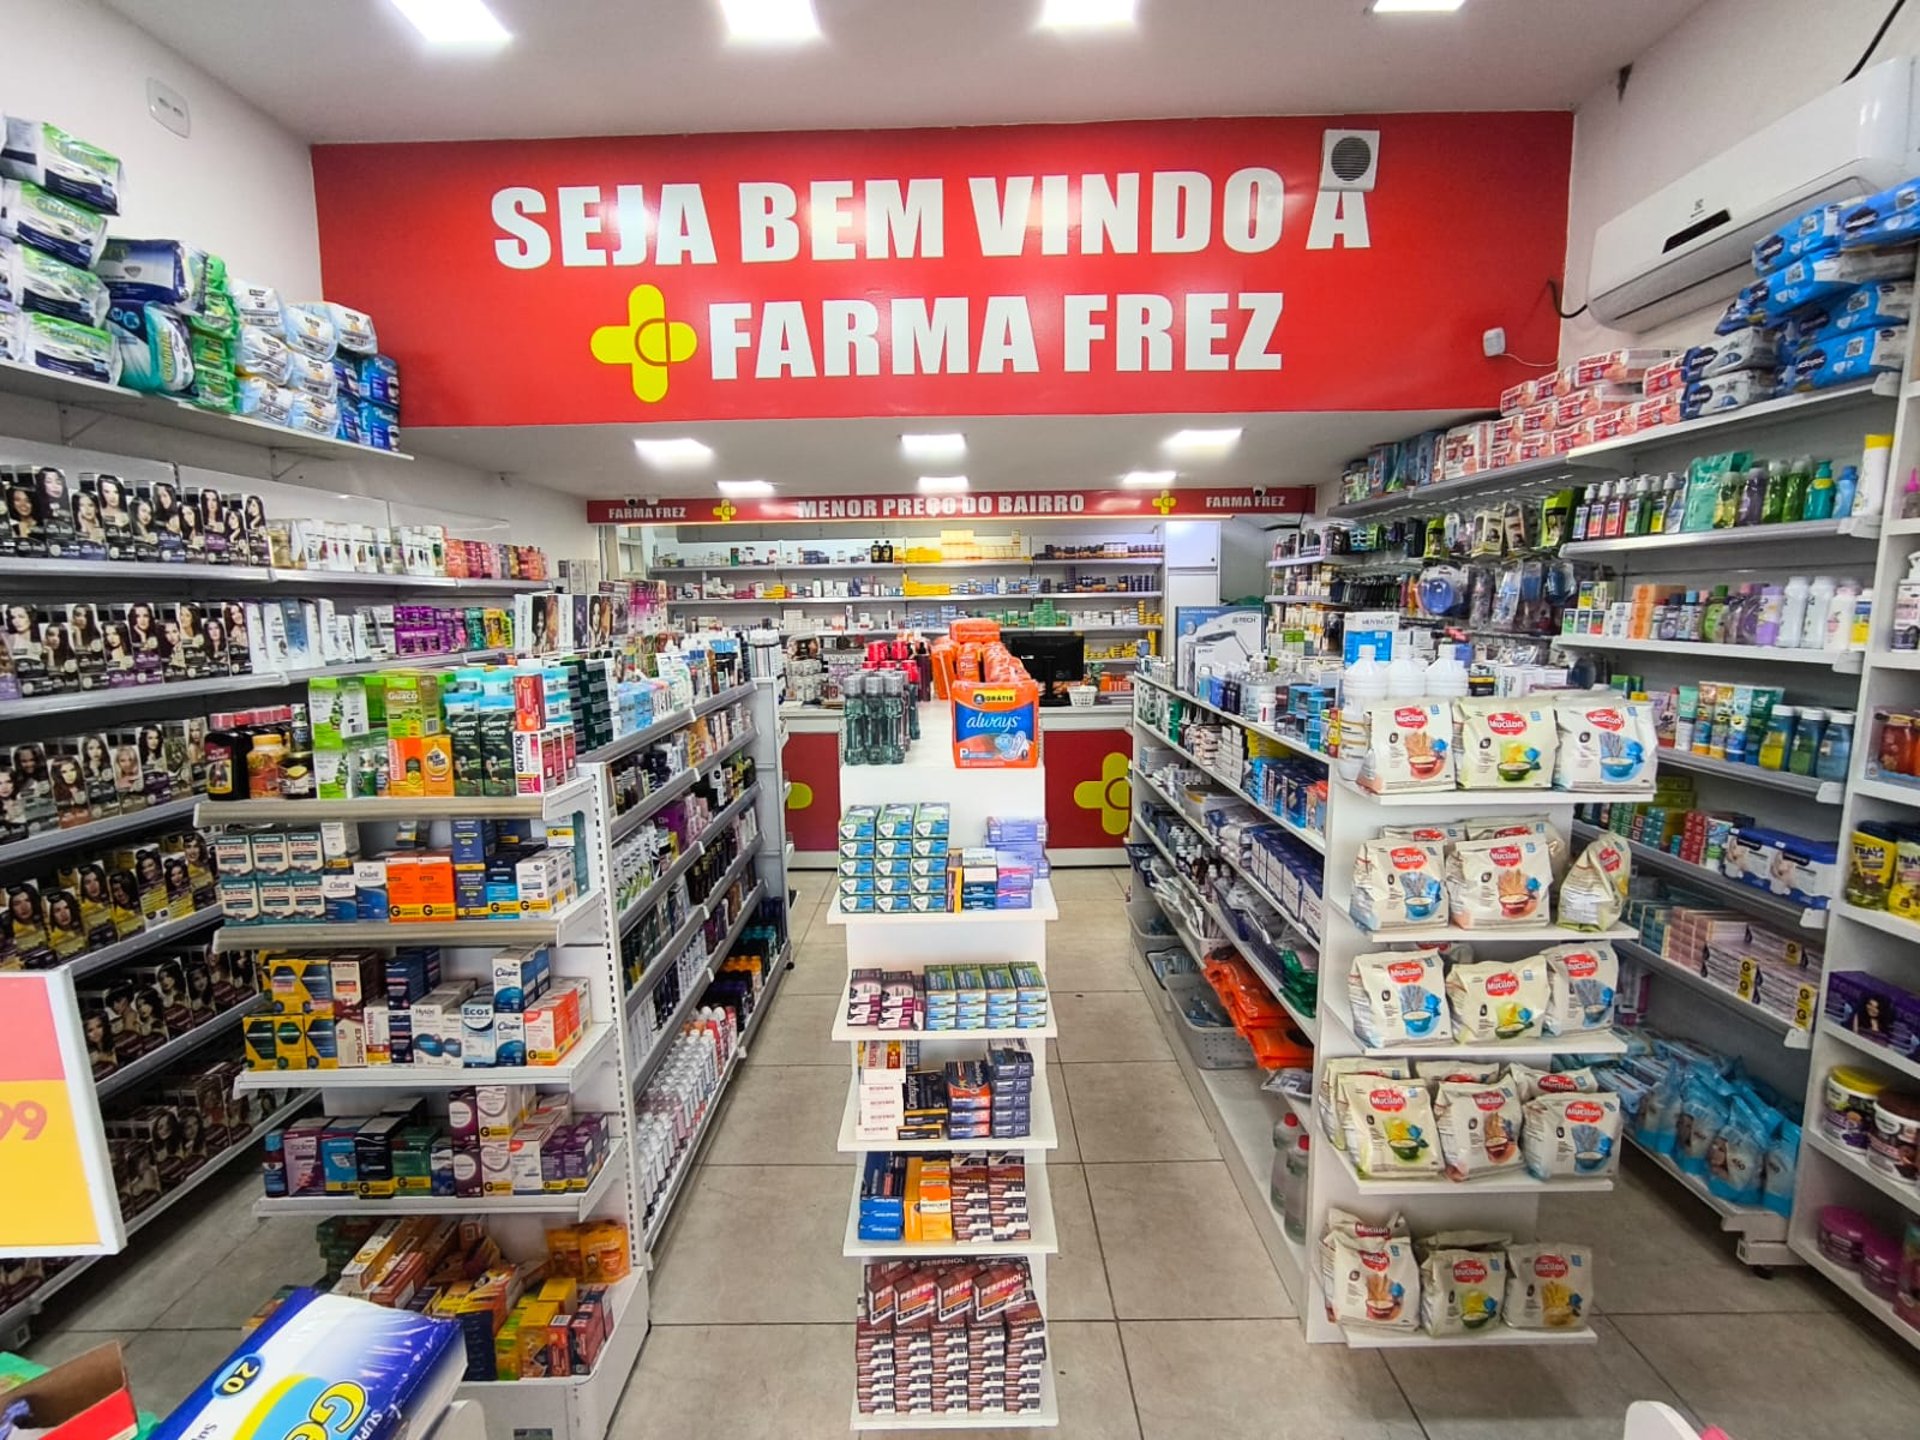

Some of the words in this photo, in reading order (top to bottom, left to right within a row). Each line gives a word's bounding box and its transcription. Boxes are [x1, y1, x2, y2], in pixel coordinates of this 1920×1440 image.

[491, 183, 718, 270] SEJA
[738, 178, 945, 264] BEM
[968, 167, 1284, 257] VINDO
[709, 296, 1040, 380] FARMA
[1063, 292, 1284, 372] FREZ
[799, 500, 877, 518] MENOR
[883, 497, 956, 518] PREÇO
[962, 496, 993, 514] DO
[998, 494, 1085, 513] BAIRRO
[1206, 495, 1252, 508] FARMA
[1255, 495, 1287, 507] FREZ
[608, 507, 653, 519] FARMA
[656, 507, 687, 518] FREZ
[966, 712, 1019, 732] always
[1489, 719, 1525, 729] Mucilon
[516, 734, 525, 772] GLYTEOL
[391, 905, 401, 917] G
[423, 904, 433, 916] G
[521, 900, 530, 910] G
[1390, 968, 1422, 978] Mucilon
[1487, 980, 1518, 991] Mucilon
[528, 1050, 537, 1060] G
[1371, 1096, 1404, 1106] Mucilon
[480, 1127, 490, 1137] G
[921, 1258, 965, 1267] PERFENOL
[981, 1273, 1023, 1296] PERFENOL
[222, 1361, 260, 1394] 20
